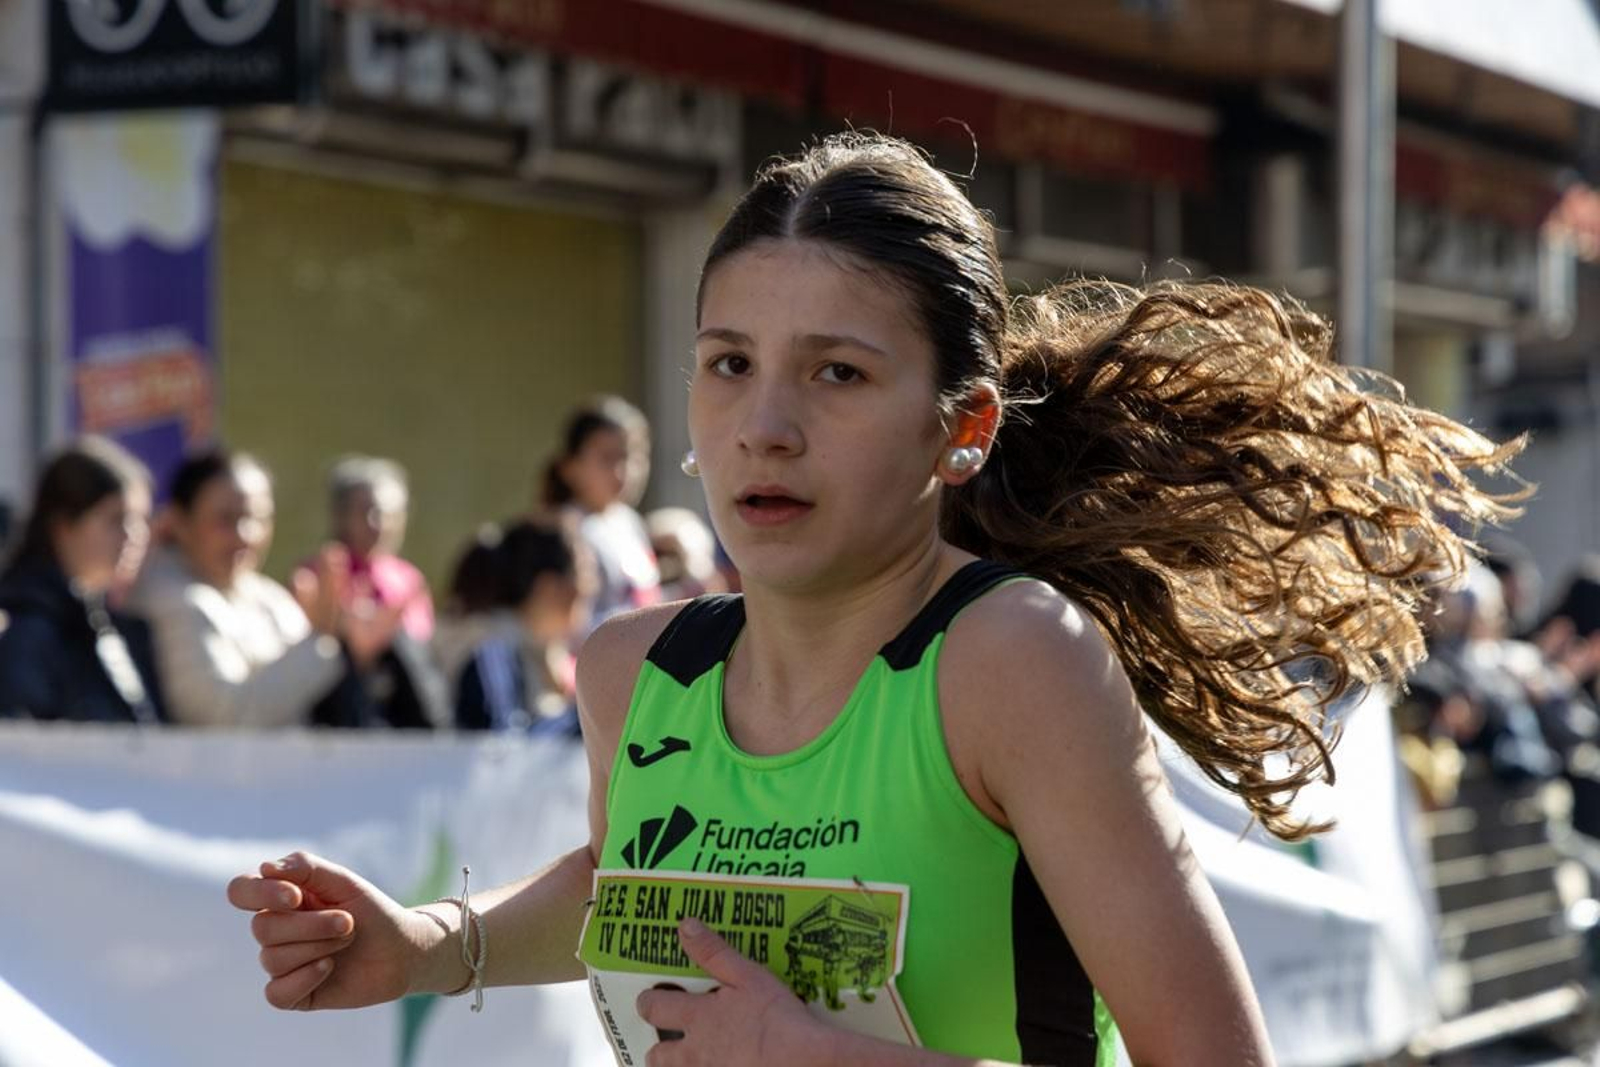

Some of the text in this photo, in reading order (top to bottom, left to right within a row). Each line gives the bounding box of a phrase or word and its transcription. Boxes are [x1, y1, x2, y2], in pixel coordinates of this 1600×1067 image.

[700, 815, 860, 850] Fundación
[634, 885, 671, 920] SAN
[676, 887, 725, 924] JUAN
[732, 891, 785, 928] BOSCO
[598, 922, 616, 953] IV
